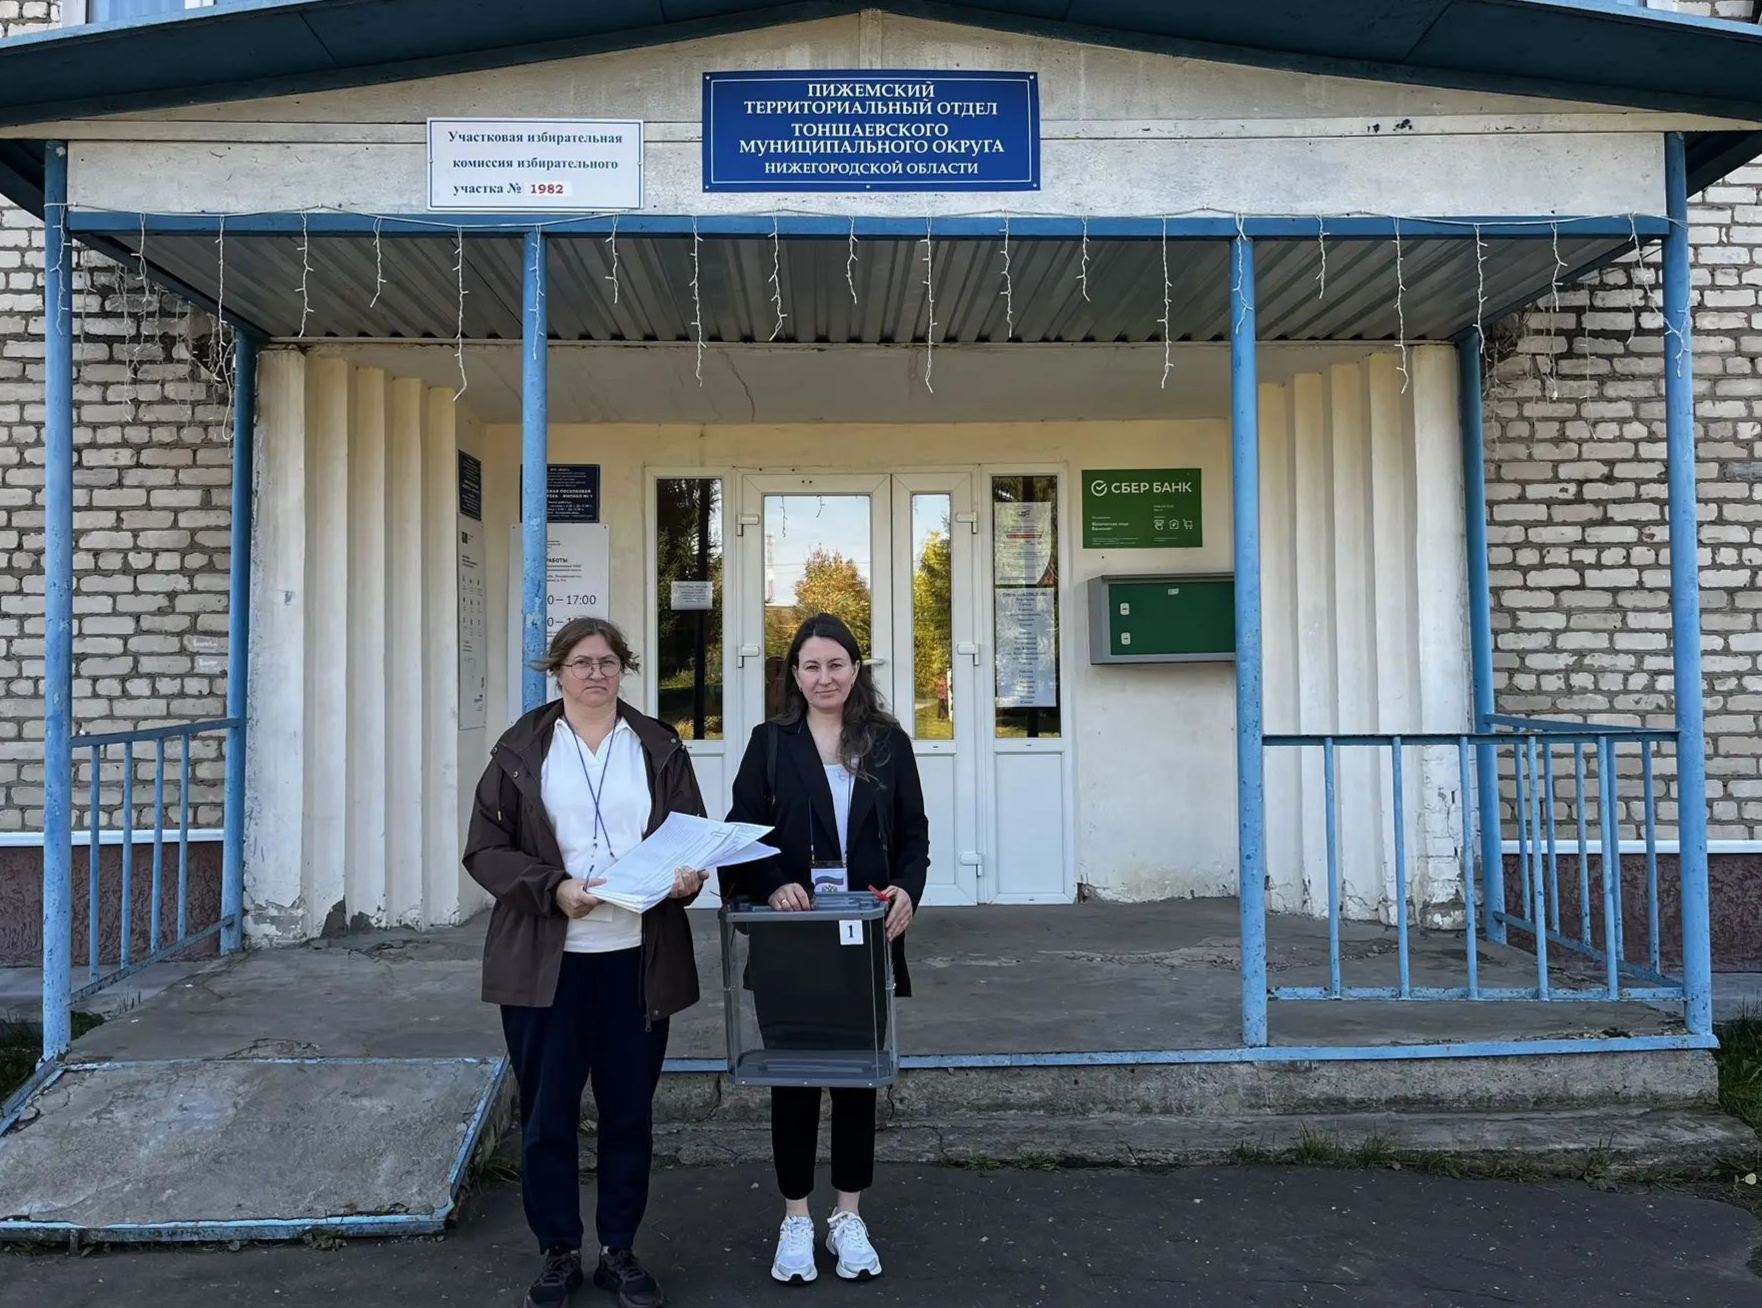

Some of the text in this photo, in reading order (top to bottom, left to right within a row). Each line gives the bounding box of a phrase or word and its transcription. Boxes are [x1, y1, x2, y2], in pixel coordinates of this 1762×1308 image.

[807, 80, 935, 98] ПИЖЕМСКИЙ
[743, 99, 998, 118] ТЕРРИТОРИАЛЬНЫЙ ОТДЕЛ
[791, 123, 949, 137] ТОНШАЕВСКОГО
[448, 131, 623, 145] Участковая избирательная
[739, 139, 1005, 156] МУНИЦИПАЛЬНОГО ОКРУГА
[452, 157, 619, 171] комиссия избирательного
[764, 160, 979, 176] НИЖЕГОРОДСКОЙ ОБЛАСТИ
[453, 183, 564, 196] участка № 1982
[1111, 482, 1192, 494] СБЕР БАНК
[566, 594, 597, 605] 17:00
[848, 924, 854, 938] 1
